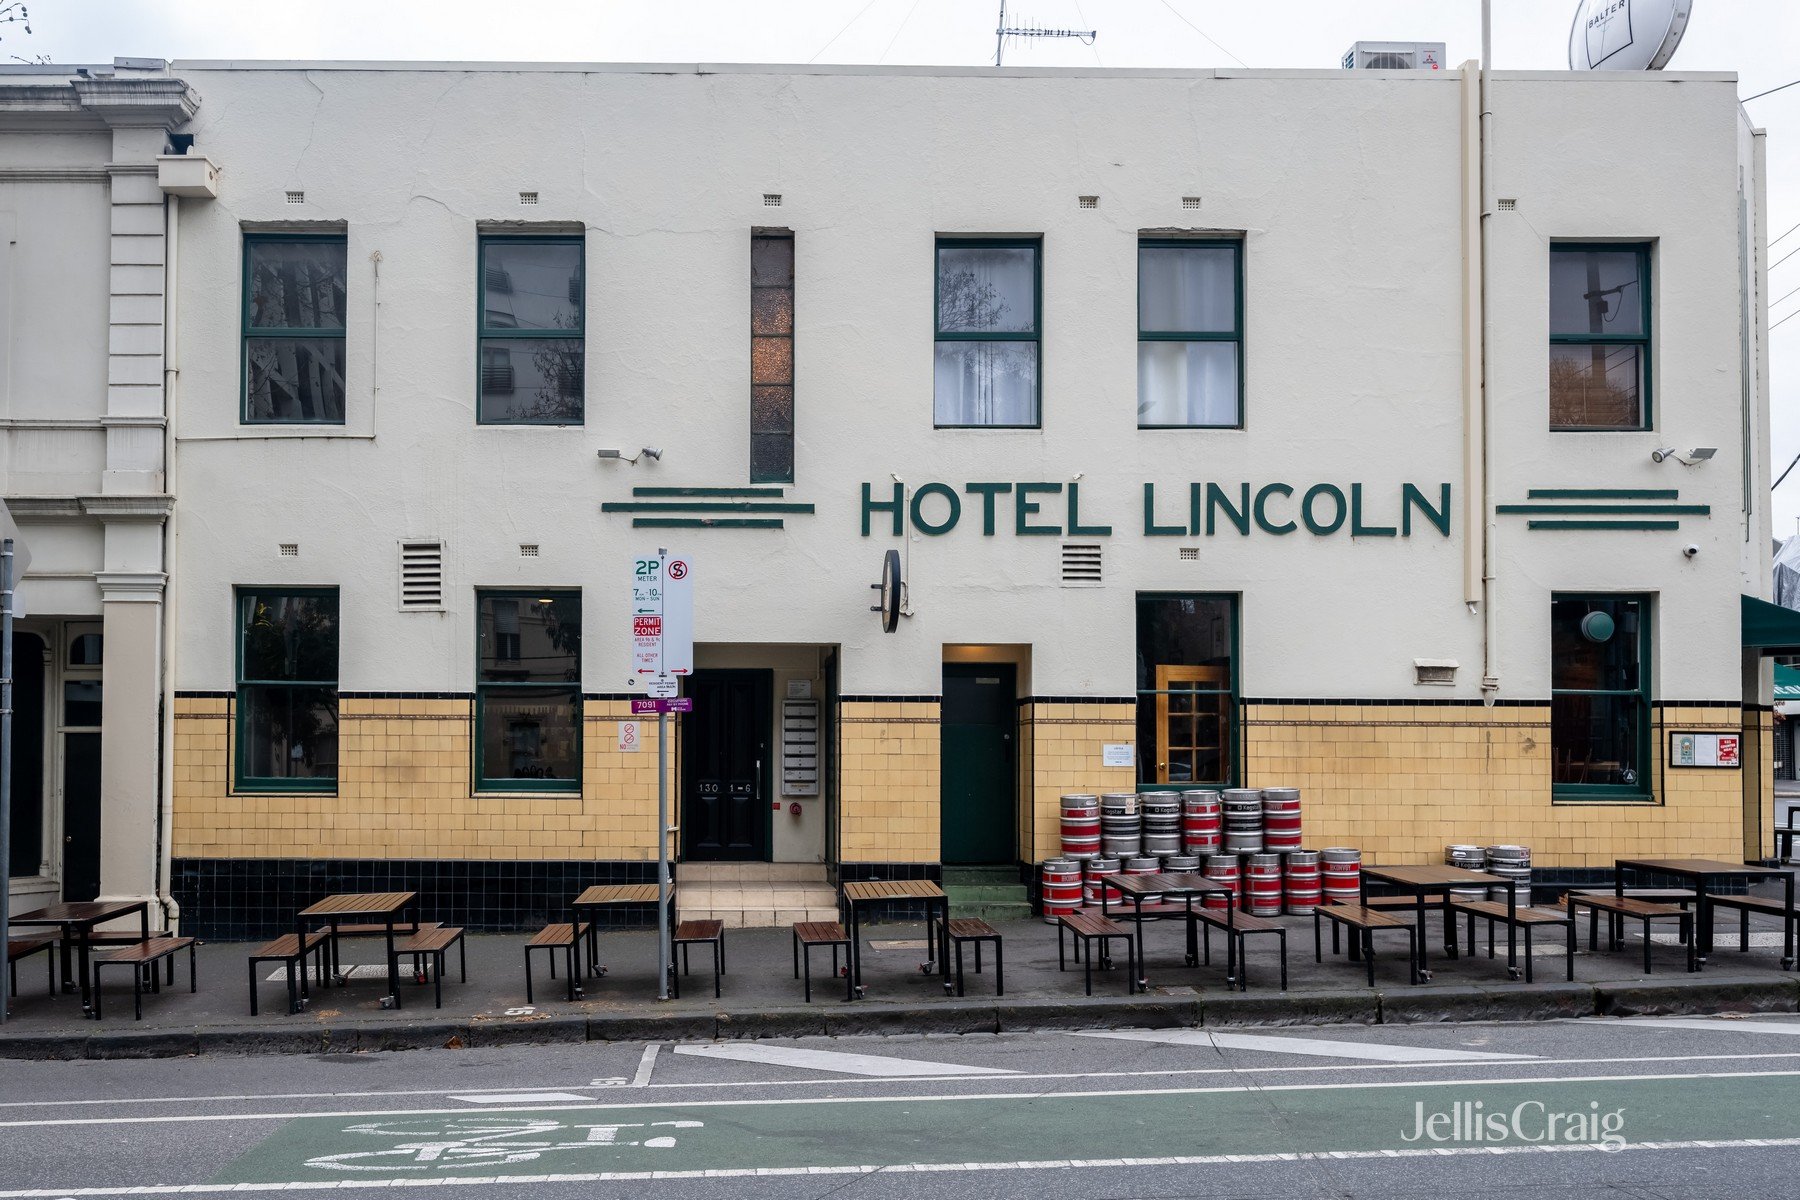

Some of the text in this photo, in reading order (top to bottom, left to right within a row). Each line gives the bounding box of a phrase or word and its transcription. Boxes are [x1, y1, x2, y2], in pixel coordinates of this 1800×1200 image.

[1589, 0, 1625, 29] BALTER
[861, 482, 1451, 537] HOTEL LINCOLN
[635, 560, 660, 575] 2P
[634, 617, 661, 626] PERMIT
[634, 627, 661, 635] ZONE
[637, 700, 656, 709] 7091
[699, 783, 719, 793] 130
